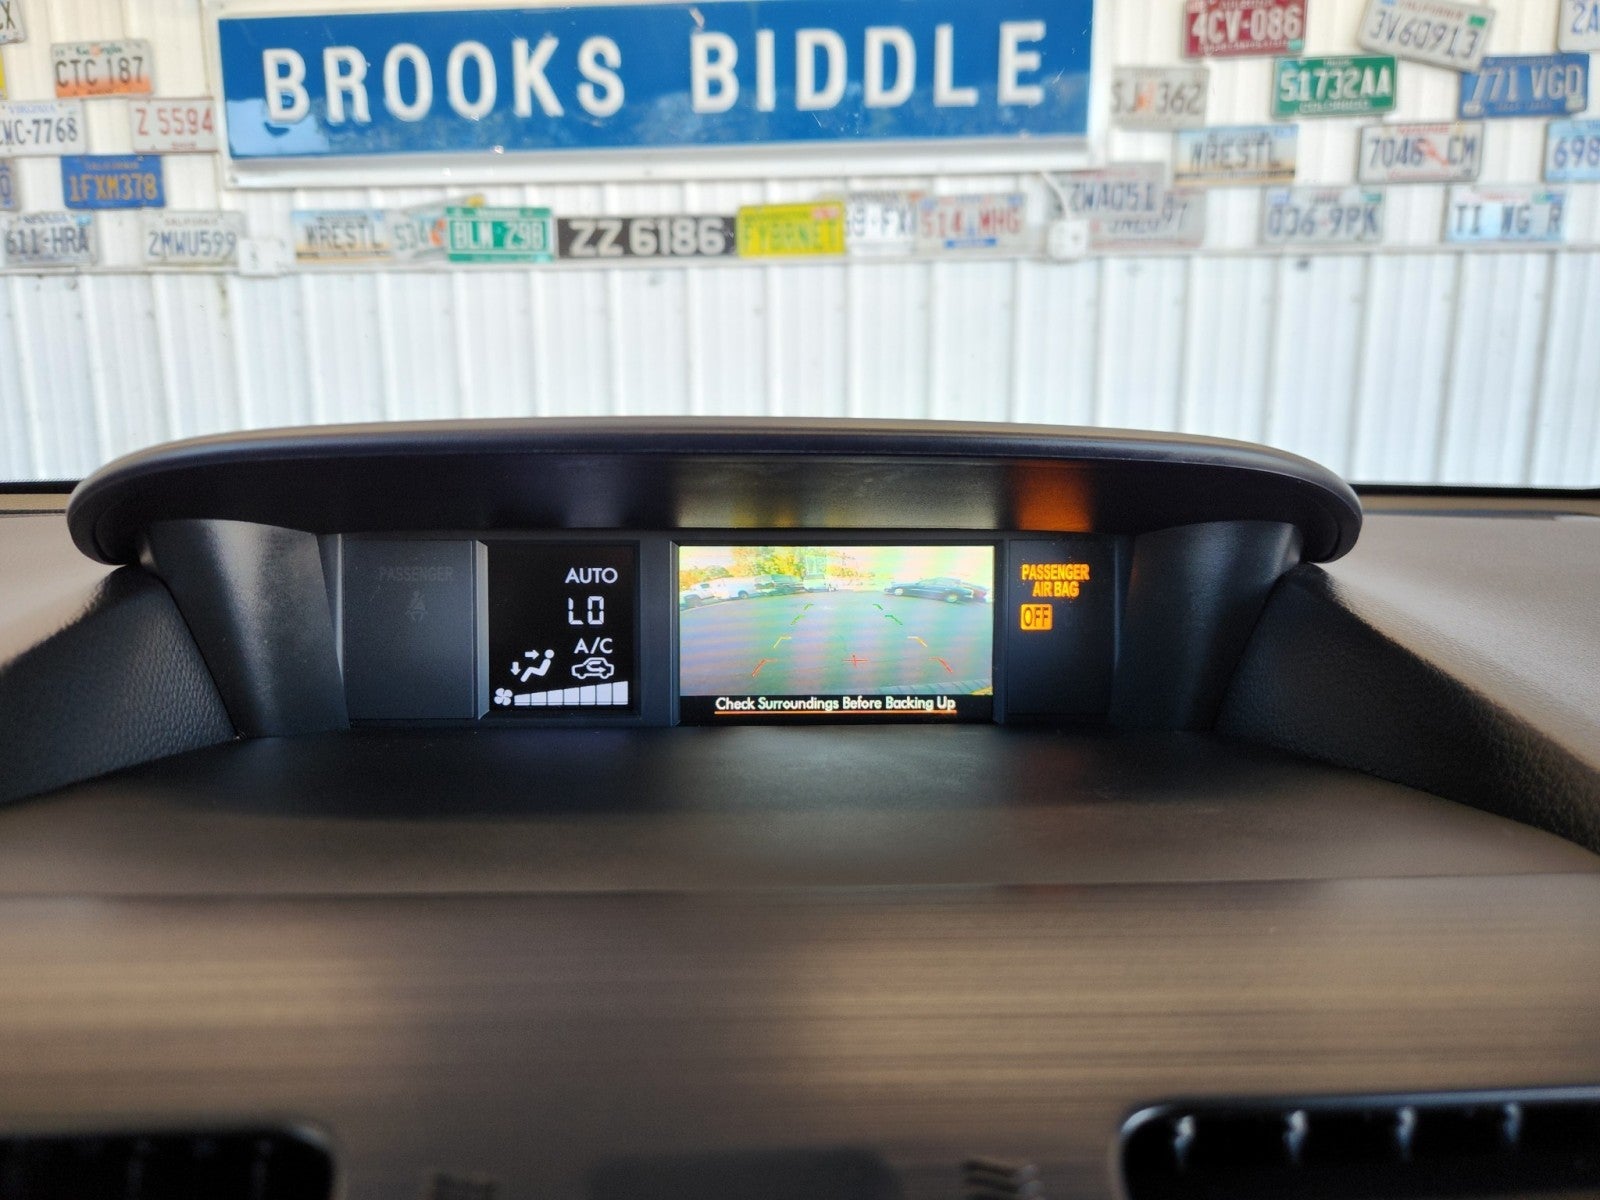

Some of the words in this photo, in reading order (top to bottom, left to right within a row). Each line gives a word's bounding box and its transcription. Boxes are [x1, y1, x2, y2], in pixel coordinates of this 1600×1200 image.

[1192, 4, 1301, 44] 4CV-086
[55, 60, 97, 87] CTC
[106, 56, 143, 85] 187
[263, 36, 626, 124] BROOKS
[689, 20, 1047, 113] BIDDLE
[0, 116, 78, 147] WC-7768
[157, 106, 214, 136] 5594
[69, 173, 158, 203] 1FXM378
[568, 219, 624, 257] ZZ
[629, 217, 727, 256] 6186
[564, 567, 619, 584] AUTO
[1021, 563, 1090, 581] PASSENGER
[1032, 580, 1053, 598] AIR
[1053, 580, 1080, 598] BAG
[1023, 606, 1049, 627] OFF
[573, 636, 613, 655] A/C
[715, 696, 755, 710] Check
[757, 696, 839, 712] Surroundings
[842, 695, 882, 710] Before
[885, 695, 934, 712] Backing
[936, 695, 956, 712] Up
